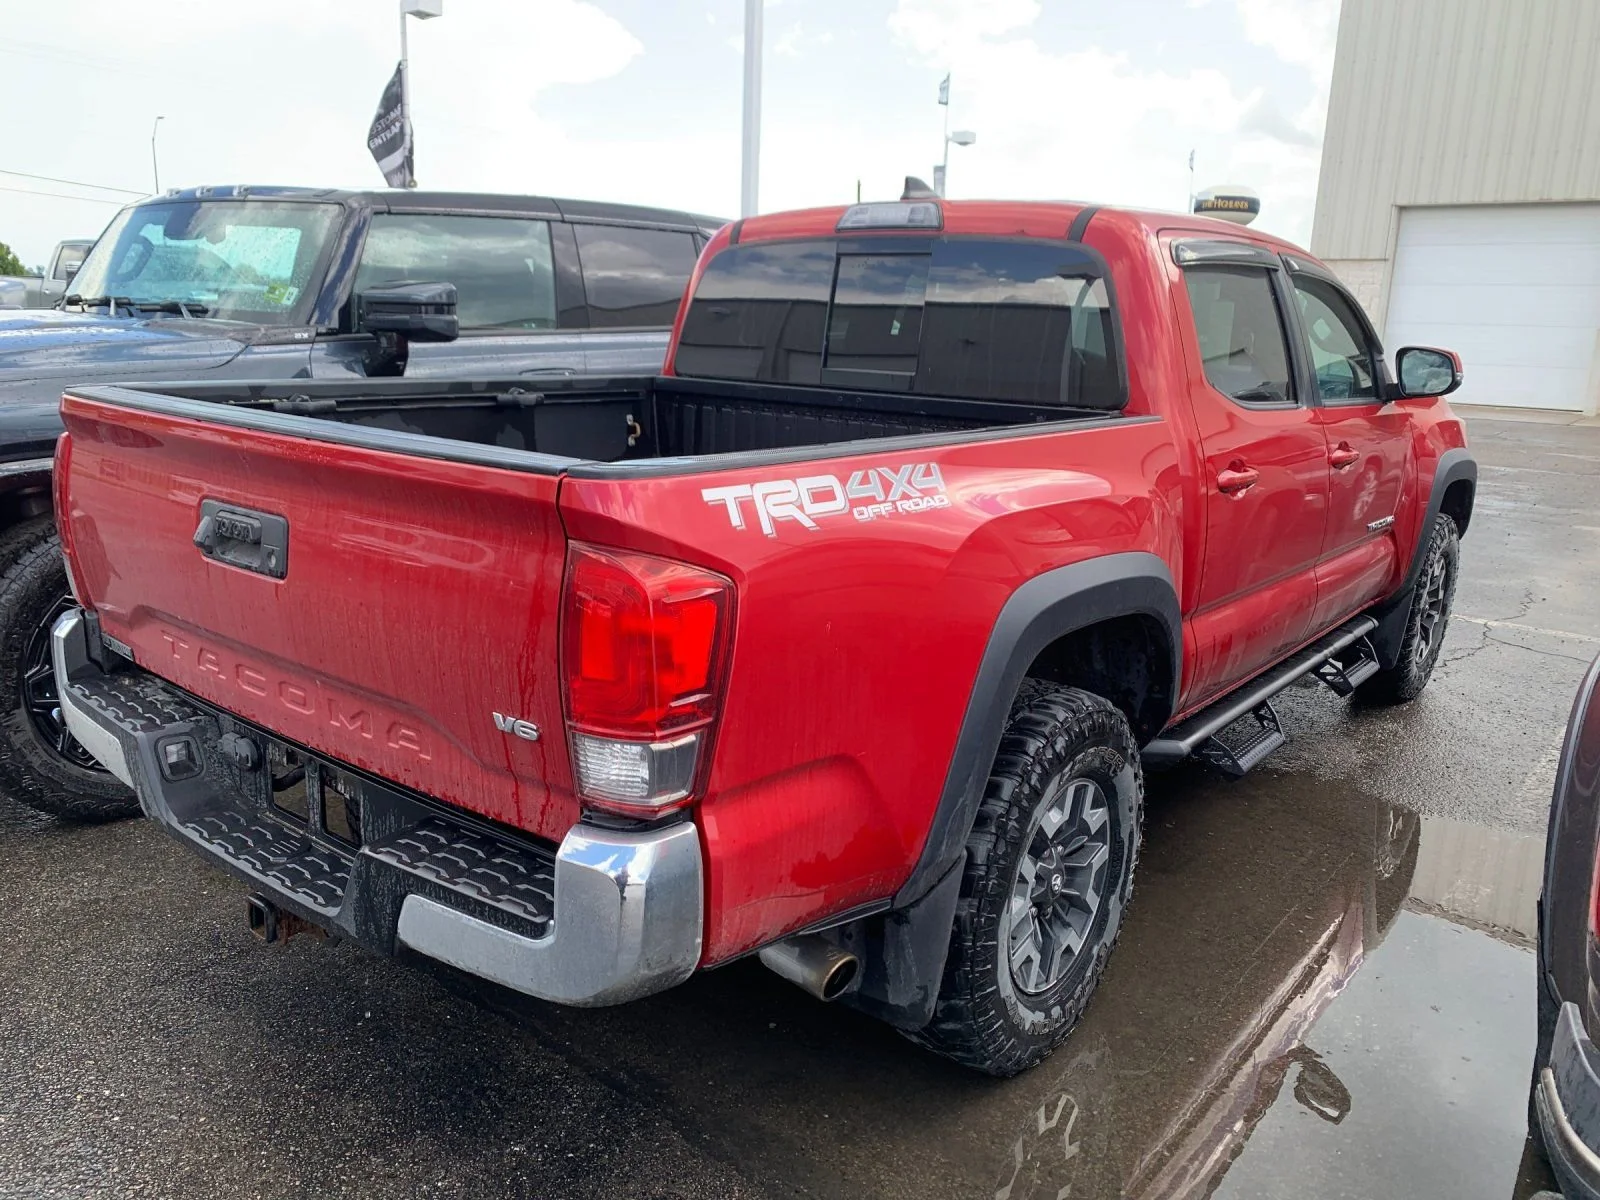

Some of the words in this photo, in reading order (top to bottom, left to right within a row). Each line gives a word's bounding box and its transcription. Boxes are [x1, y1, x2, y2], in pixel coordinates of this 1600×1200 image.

[701, 474, 849, 538] TRD
[853, 502, 894, 522] OFF
[896, 494, 951, 514] ROAD
[215, 516, 254, 542] TOYOTA
[161, 633, 433, 762] TACOMA
[492, 712, 541, 742] V6
